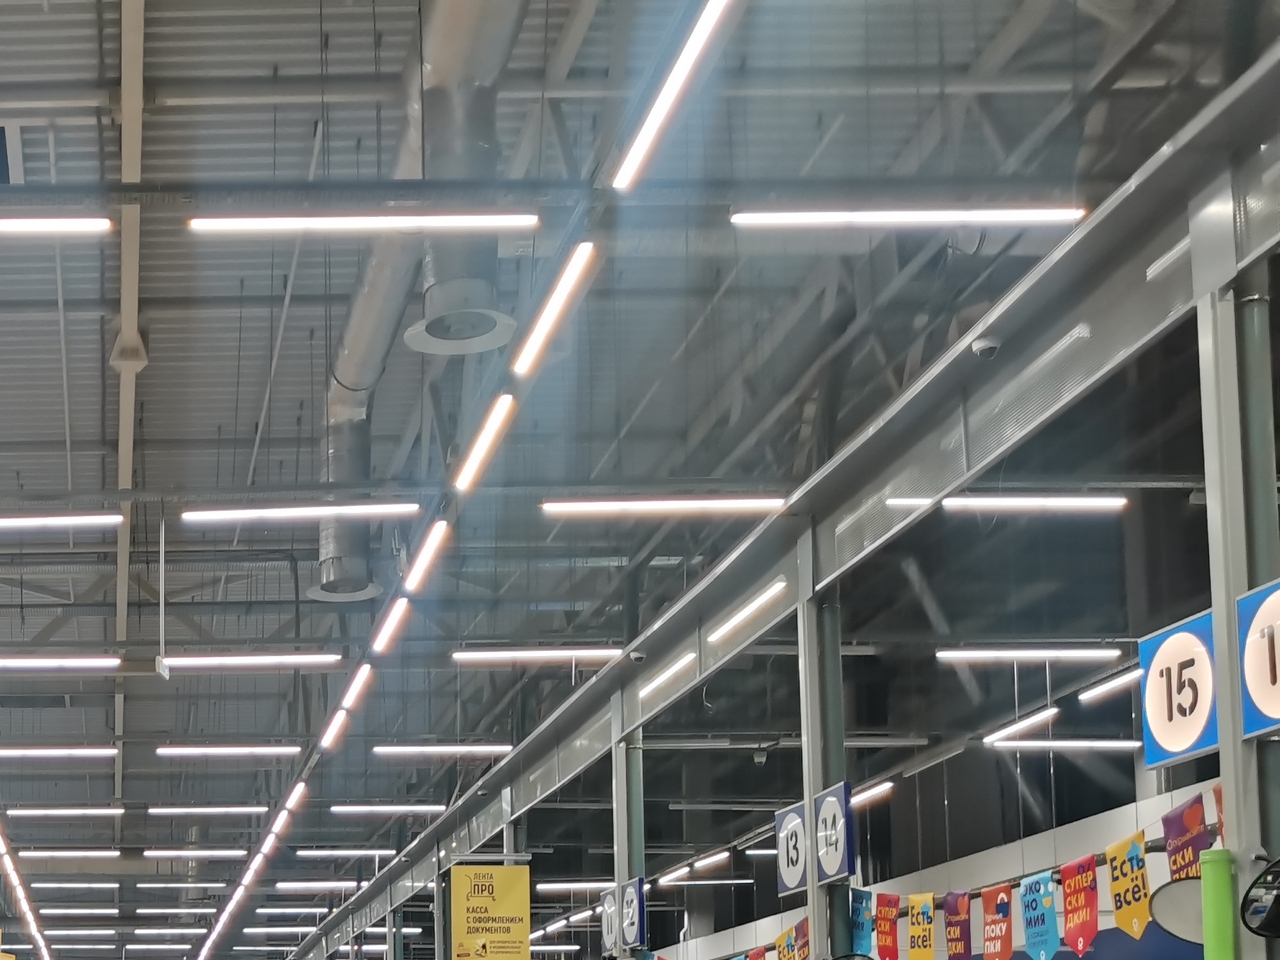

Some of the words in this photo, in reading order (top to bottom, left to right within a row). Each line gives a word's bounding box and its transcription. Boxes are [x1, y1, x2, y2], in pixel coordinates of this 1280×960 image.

[1159, 657, 1199, 723] 15
[821, 813, 839, 856] 14
[786, 829, 800, 868] 13
[1170, 846, 1193, 870] СКИ
[1109, 854, 1146, 883] Есть
[474, 884, 494, 895] ПРО
[1065, 870, 1094, 893] СУПЕР
[1066, 892, 1085, 911] СКИ
[1114, 876, 1148, 911] всё!
[466, 906, 489, 914] КАССА
[877, 906, 898, 919] СУПЕР
[1024, 898, 1038, 912] НО
[466, 916, 471, 924] С
[472, 916, 524, 924] ОФОРМЛЕНИЕМ
[910, 905, 933, 926] Есть
[1026, 913, 1046, 930] МИЯ
[466, 926, 512, 935] ДОКУМЕНТОВ
[877, 921, 890, 932] СКИ
[946, 926, 961, 940] СКИ
[984, 922, 1008, 938] ПОКУ
[910, 927, 932, 950] всё!
[984, 940, 1002, 954] ПКИ
